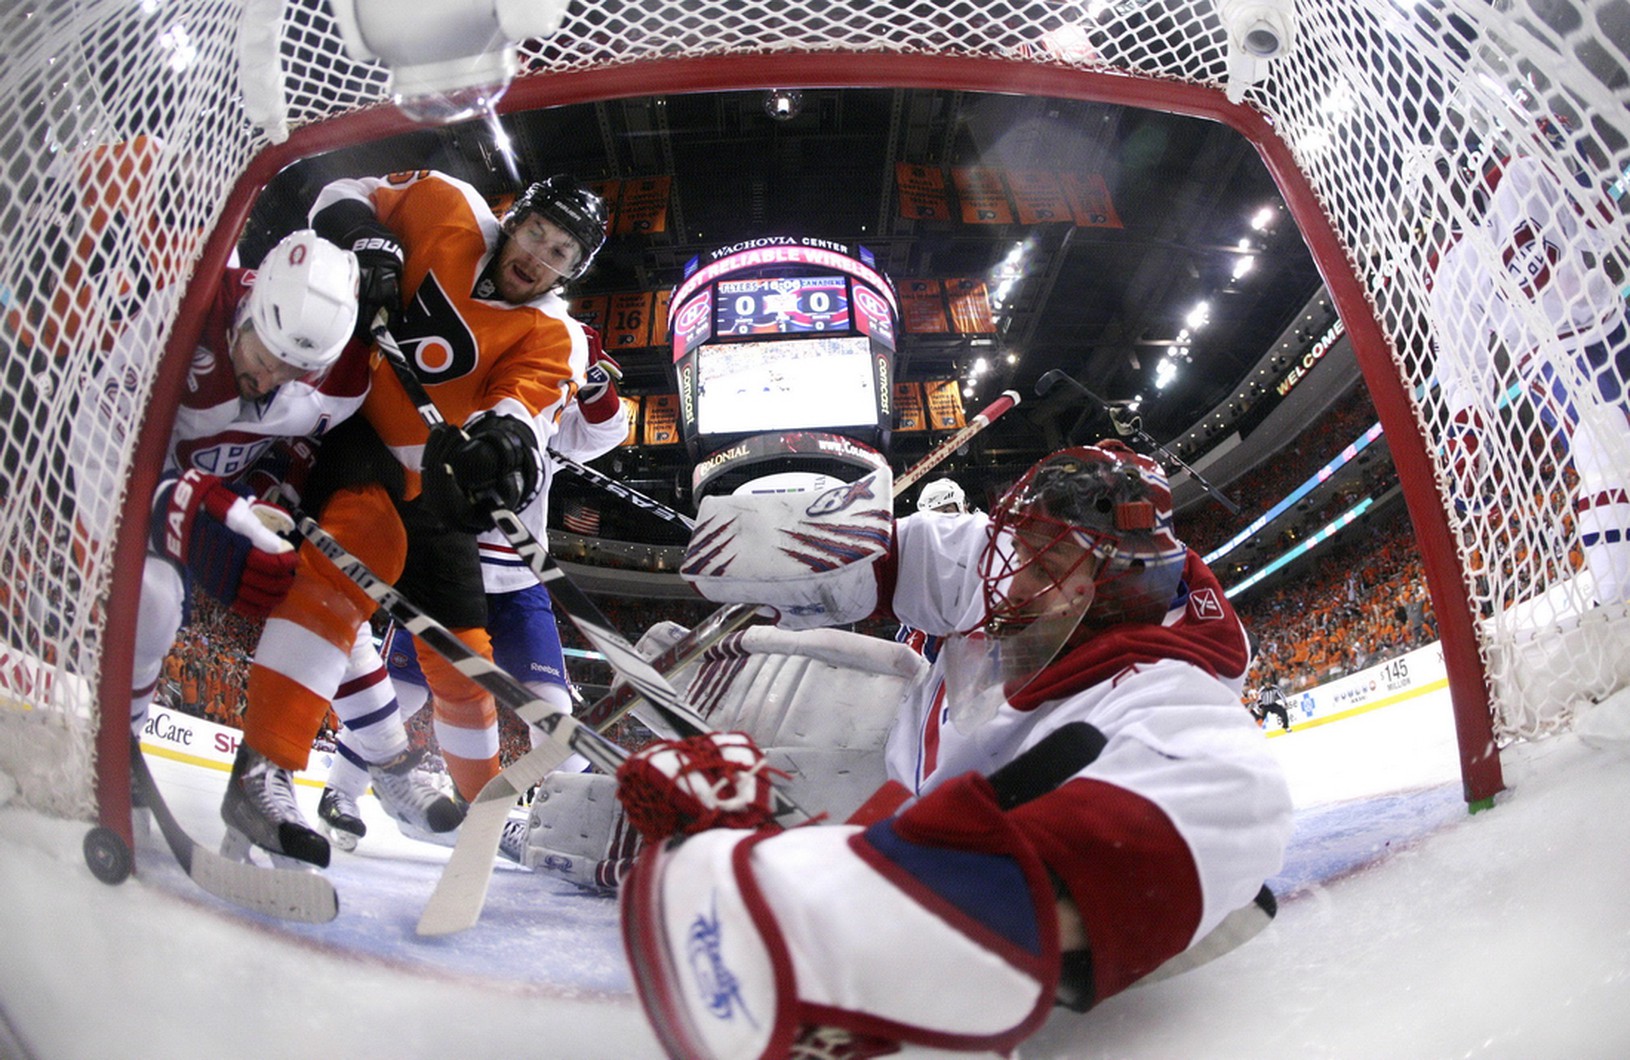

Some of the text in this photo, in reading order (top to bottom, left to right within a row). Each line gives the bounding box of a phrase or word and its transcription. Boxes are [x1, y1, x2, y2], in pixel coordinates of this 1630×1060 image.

[711, 237, 848, 259] WACHOVIA CENTER
[708, 247, 800, 279] RELIABLE
[735, 291, 831, 316] 0 0
[615, 309, 643, 330] 16
[1276, 319, 1345, 396] WELCOME
[530, 662, 561, 680] Reebok
